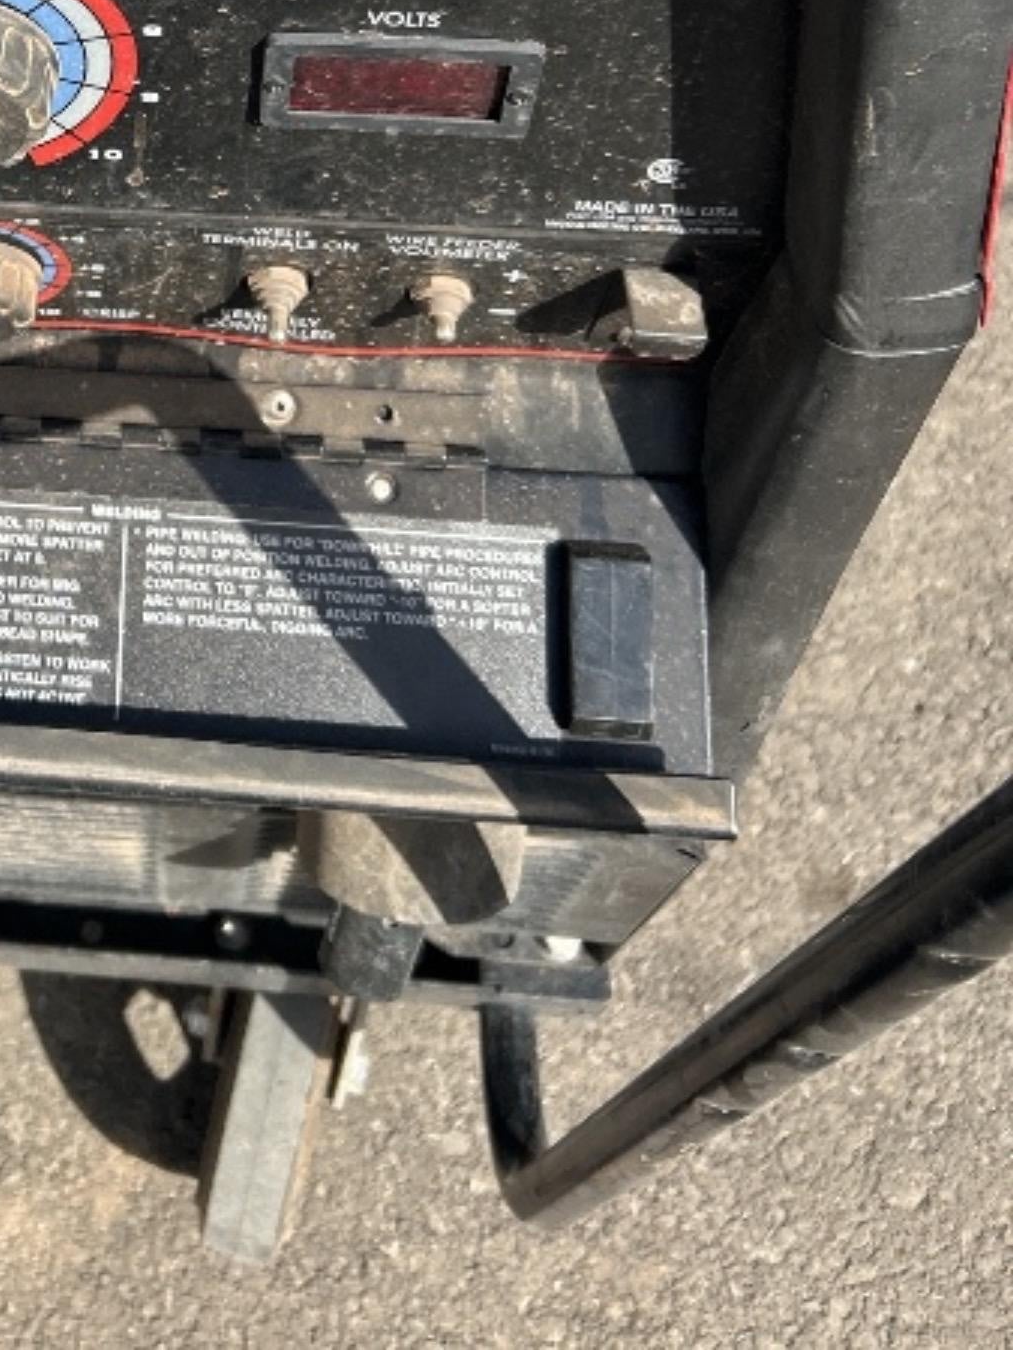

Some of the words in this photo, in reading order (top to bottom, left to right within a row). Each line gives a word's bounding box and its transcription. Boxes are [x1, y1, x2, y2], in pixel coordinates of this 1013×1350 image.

[367, 10, 442, 30] VOLTS
[88, 149, 123, 161] 10
[574, 200, 630, 214] MADE
[634, 203, 655, 215] IN
